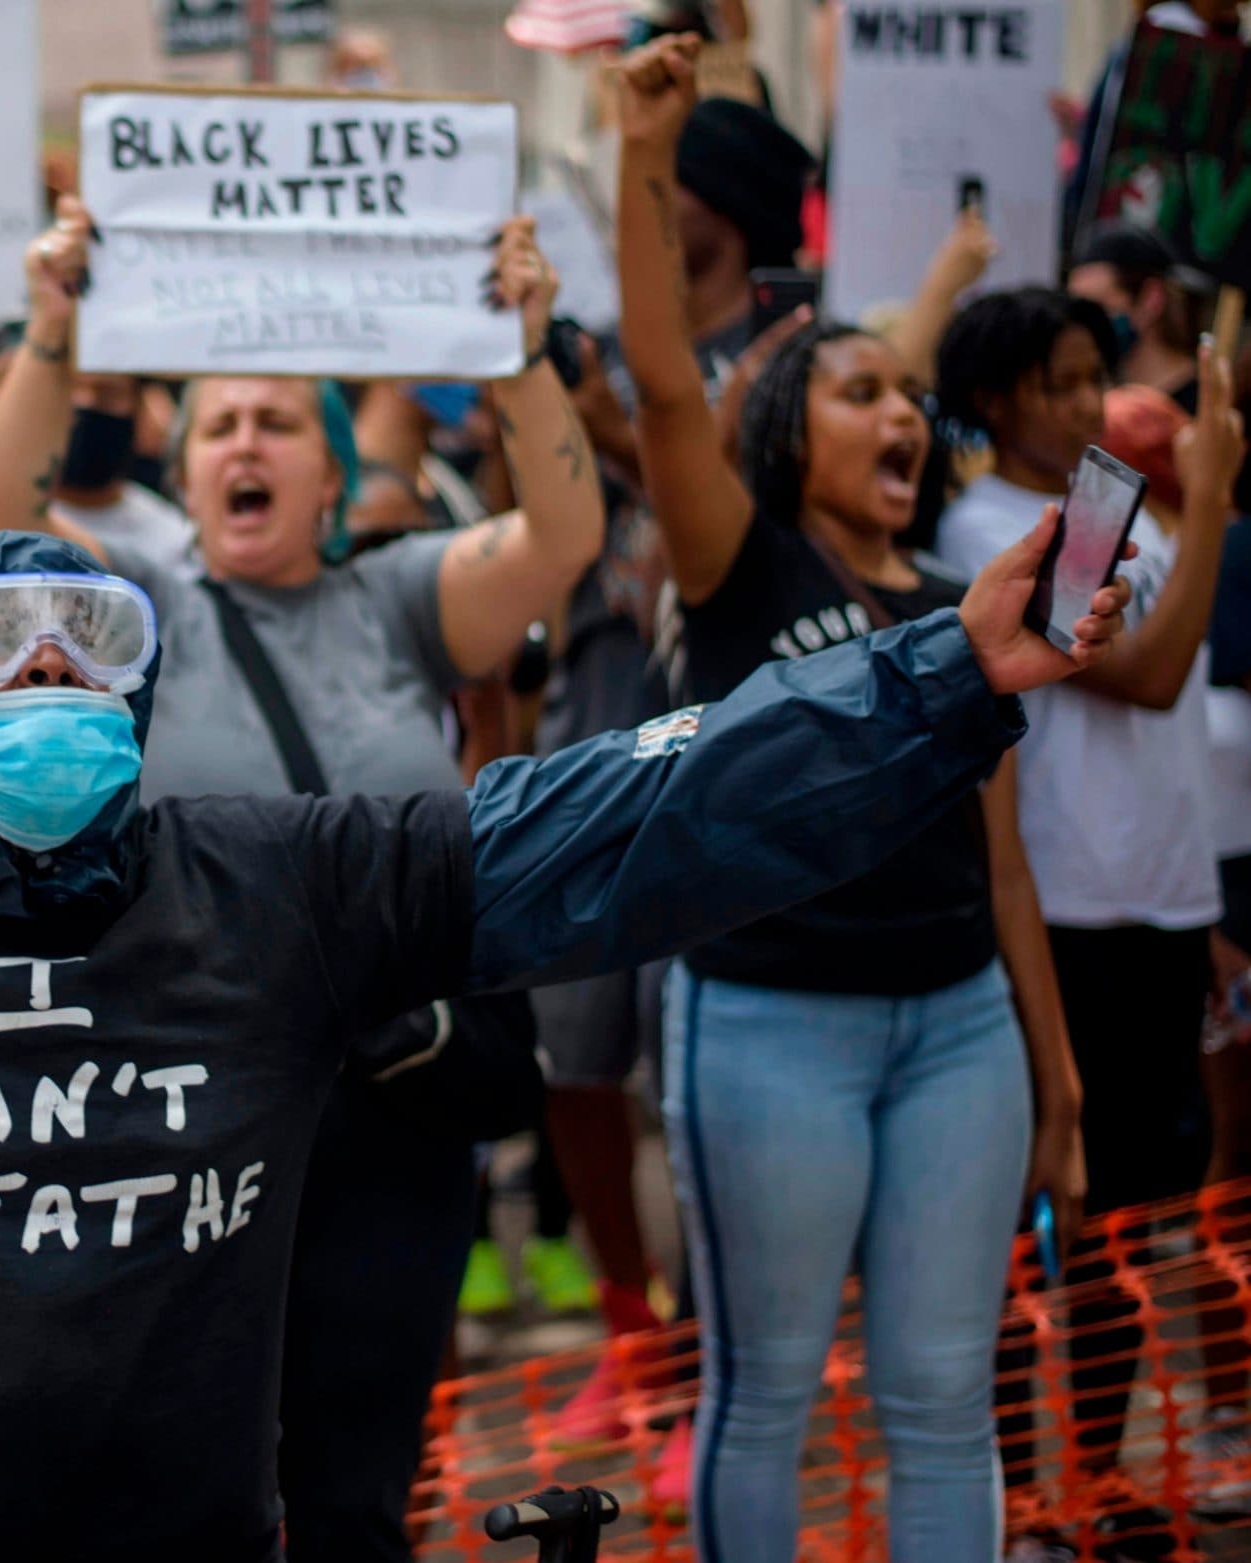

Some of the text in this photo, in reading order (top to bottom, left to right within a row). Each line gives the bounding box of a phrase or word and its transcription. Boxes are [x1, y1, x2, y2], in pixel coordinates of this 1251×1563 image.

[850, 7, 1031, 62] WHITE
[109, 116, 461, 171] BLACK LIVES
[211, 173, 407, 219] MATTER
[151, 268, 455, 303] NOT ALL LIVES
[213, 309, 387, 345] MATTER
